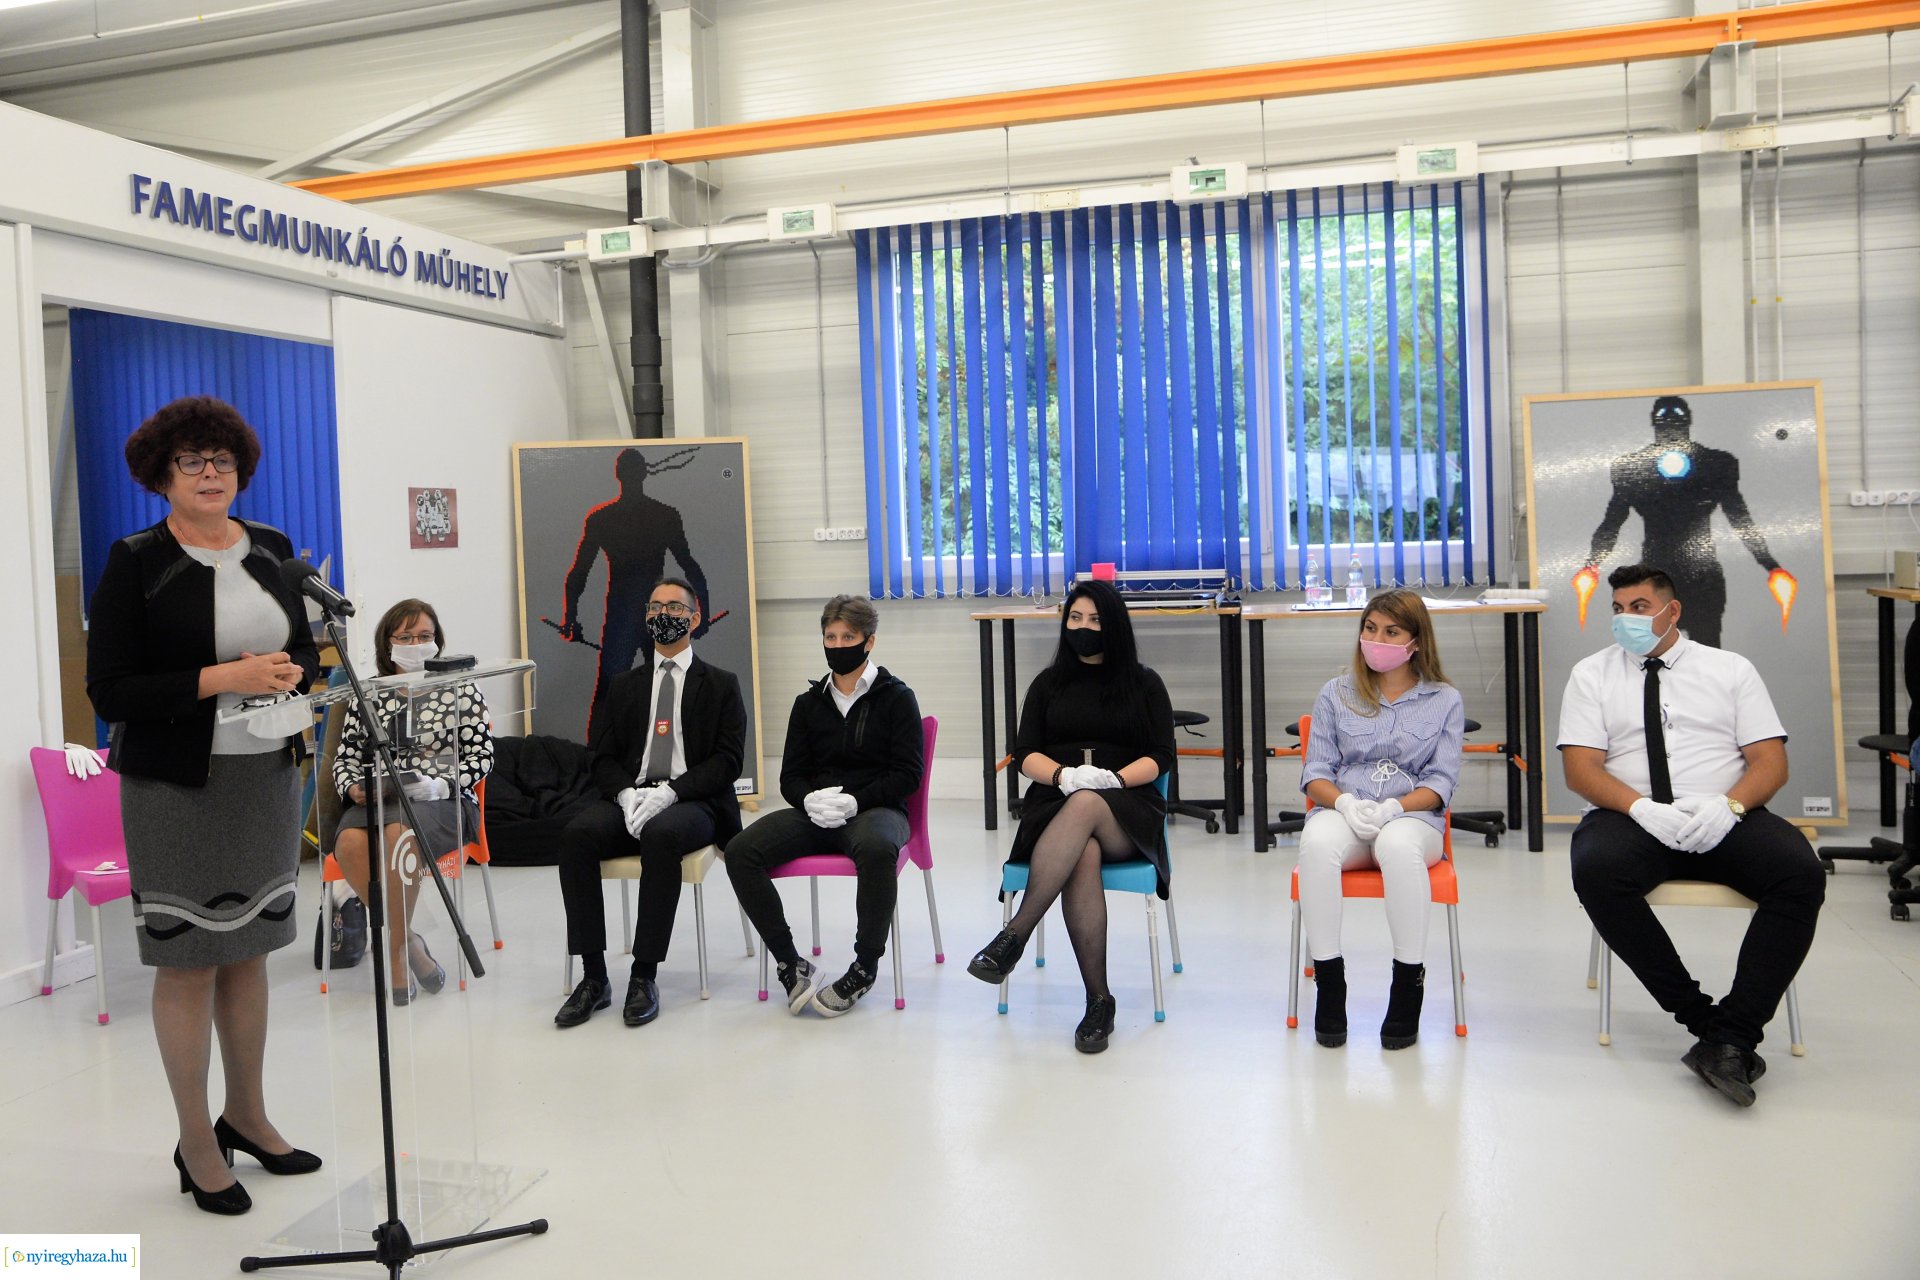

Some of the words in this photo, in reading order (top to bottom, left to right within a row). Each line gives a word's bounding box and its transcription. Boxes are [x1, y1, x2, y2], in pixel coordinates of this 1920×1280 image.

[130, 173, 407, 277] FAMEGMUNKÁLÓ
[415, 248, 508, 299] MŰHELY
[418, 857, 456, 878] NYÍYHÁZI
